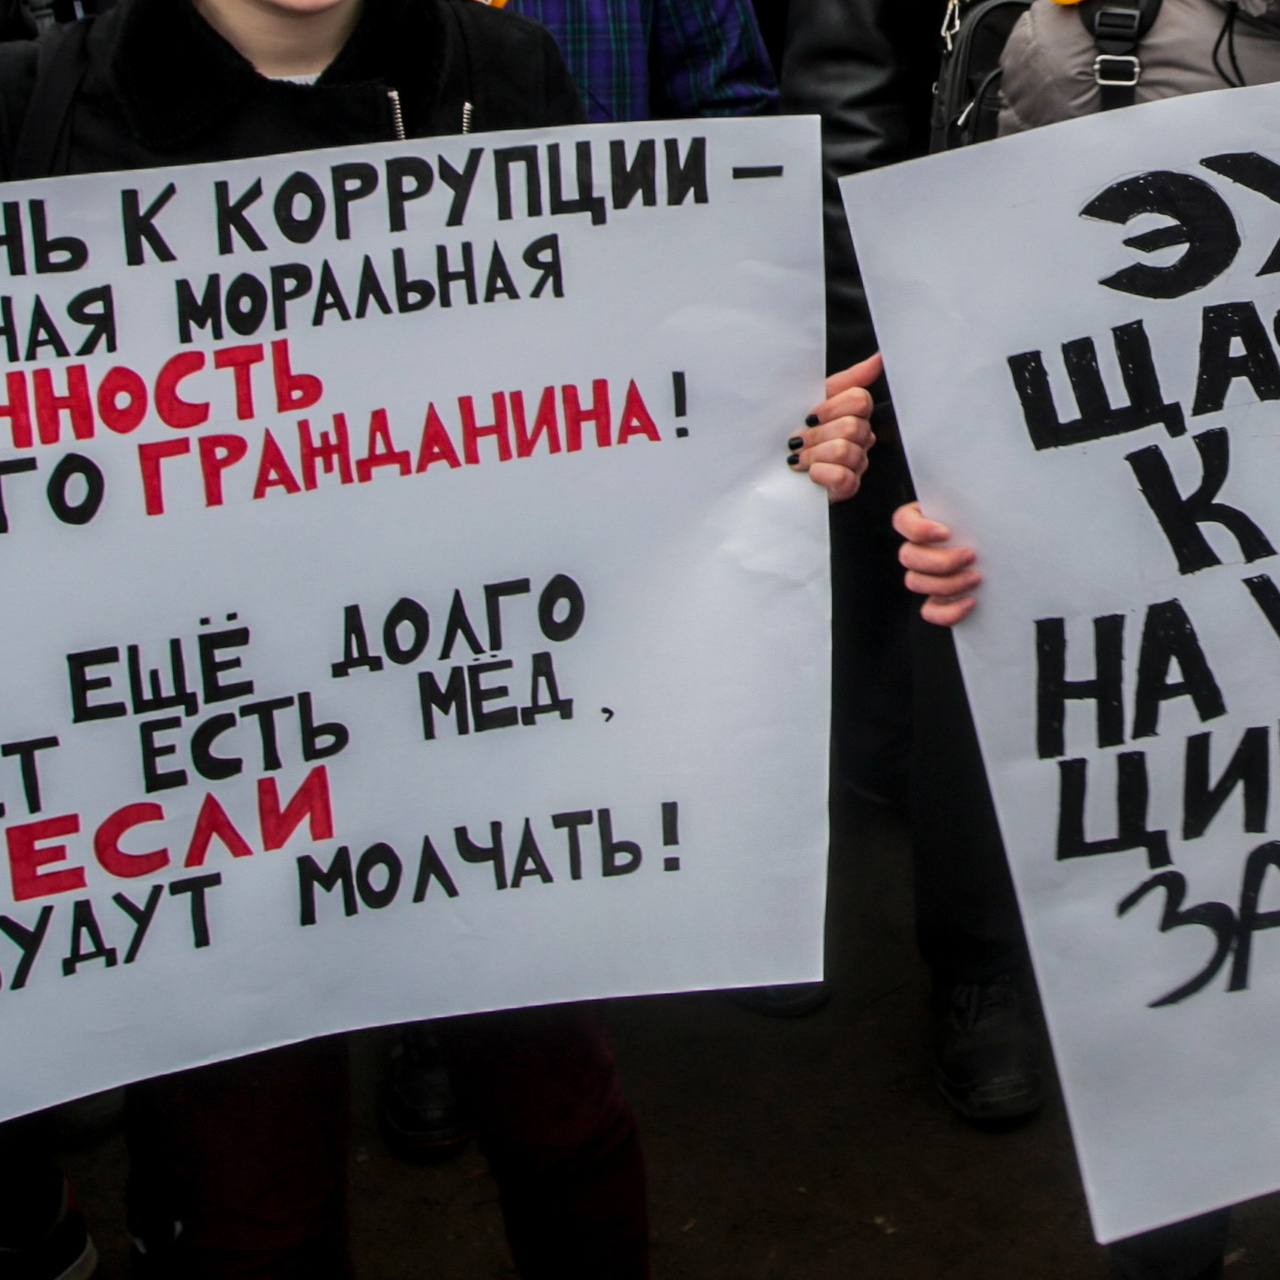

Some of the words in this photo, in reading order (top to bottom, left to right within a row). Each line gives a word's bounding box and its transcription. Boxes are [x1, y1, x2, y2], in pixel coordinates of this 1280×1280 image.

[121, 183, 176, 266] К
[215, 137, 708, 255] КОРРУПЦИИ
[176, 234, 564, 343] МОРАЛЬНАЯ
[139, 372, 687, 515] ГРАЖДАНИНА!
[1124, 427, 1278, 575] К
[66, 612, 254, 724] ЕЩЁ
[331, 574, 584, 678] ДОЛГО
[1034, 598, 1227, 759] НА
[0, 736, 60, 818] Т
[140, 692, 348, 793] ЕСТЬ
[6, 765, 333, 901] ЕСЛИ
[297, 802, 680, 926] МОЛЧАТЬ!
